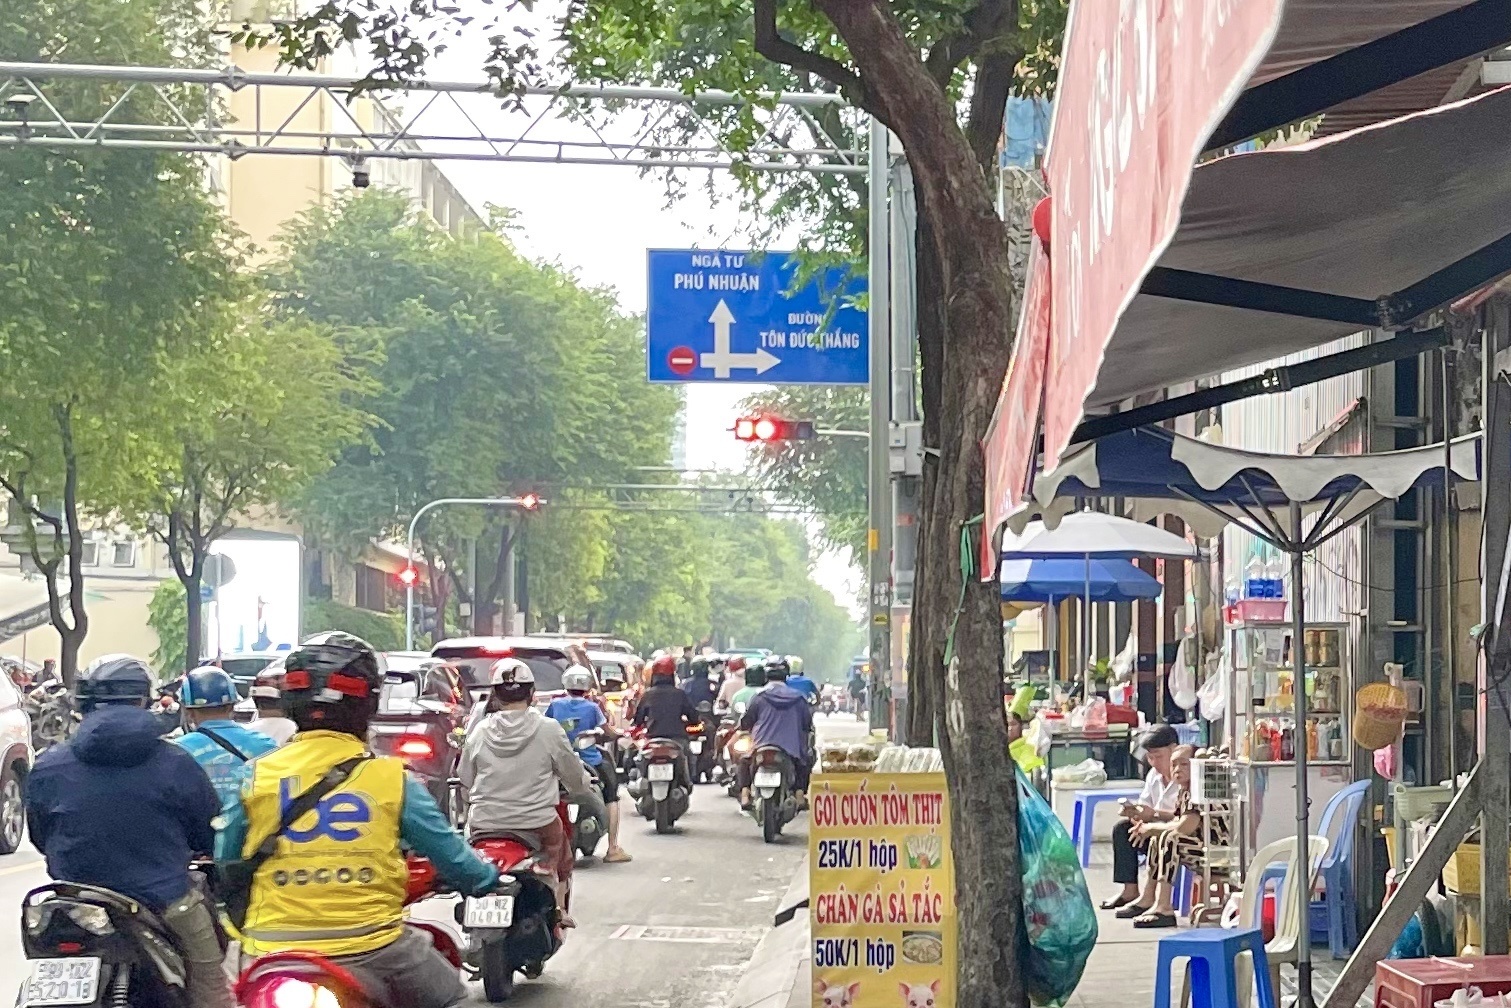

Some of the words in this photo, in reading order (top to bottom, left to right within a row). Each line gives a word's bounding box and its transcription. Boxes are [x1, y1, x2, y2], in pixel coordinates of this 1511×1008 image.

[725, 254, 744, 269] TƯ
[674, 270, 704, 290] PHÚ
[709, 273, 760, 294] NHUẬN
[788, 311, 827, 325] ĐƯỜN
[760, 329, 785, 348] TÔN
[280, 778, 370, 843] be
[841, 779, 877, 826] CUỐN
[881, 783, 909, 825] TÔM
[912, 793, 943, 833] THỊT
[818, 839, 861, 869] 25K/1
[869, 838, 898, 873] hộp
[816, 885, 859, 924] CHÂN
[862, 883, 884, 924] GÀ
[912, 876, 942, 924] TẮC
[815, 938, 859, 967] 50K/1
[866, 937, 895, 973] hộp
